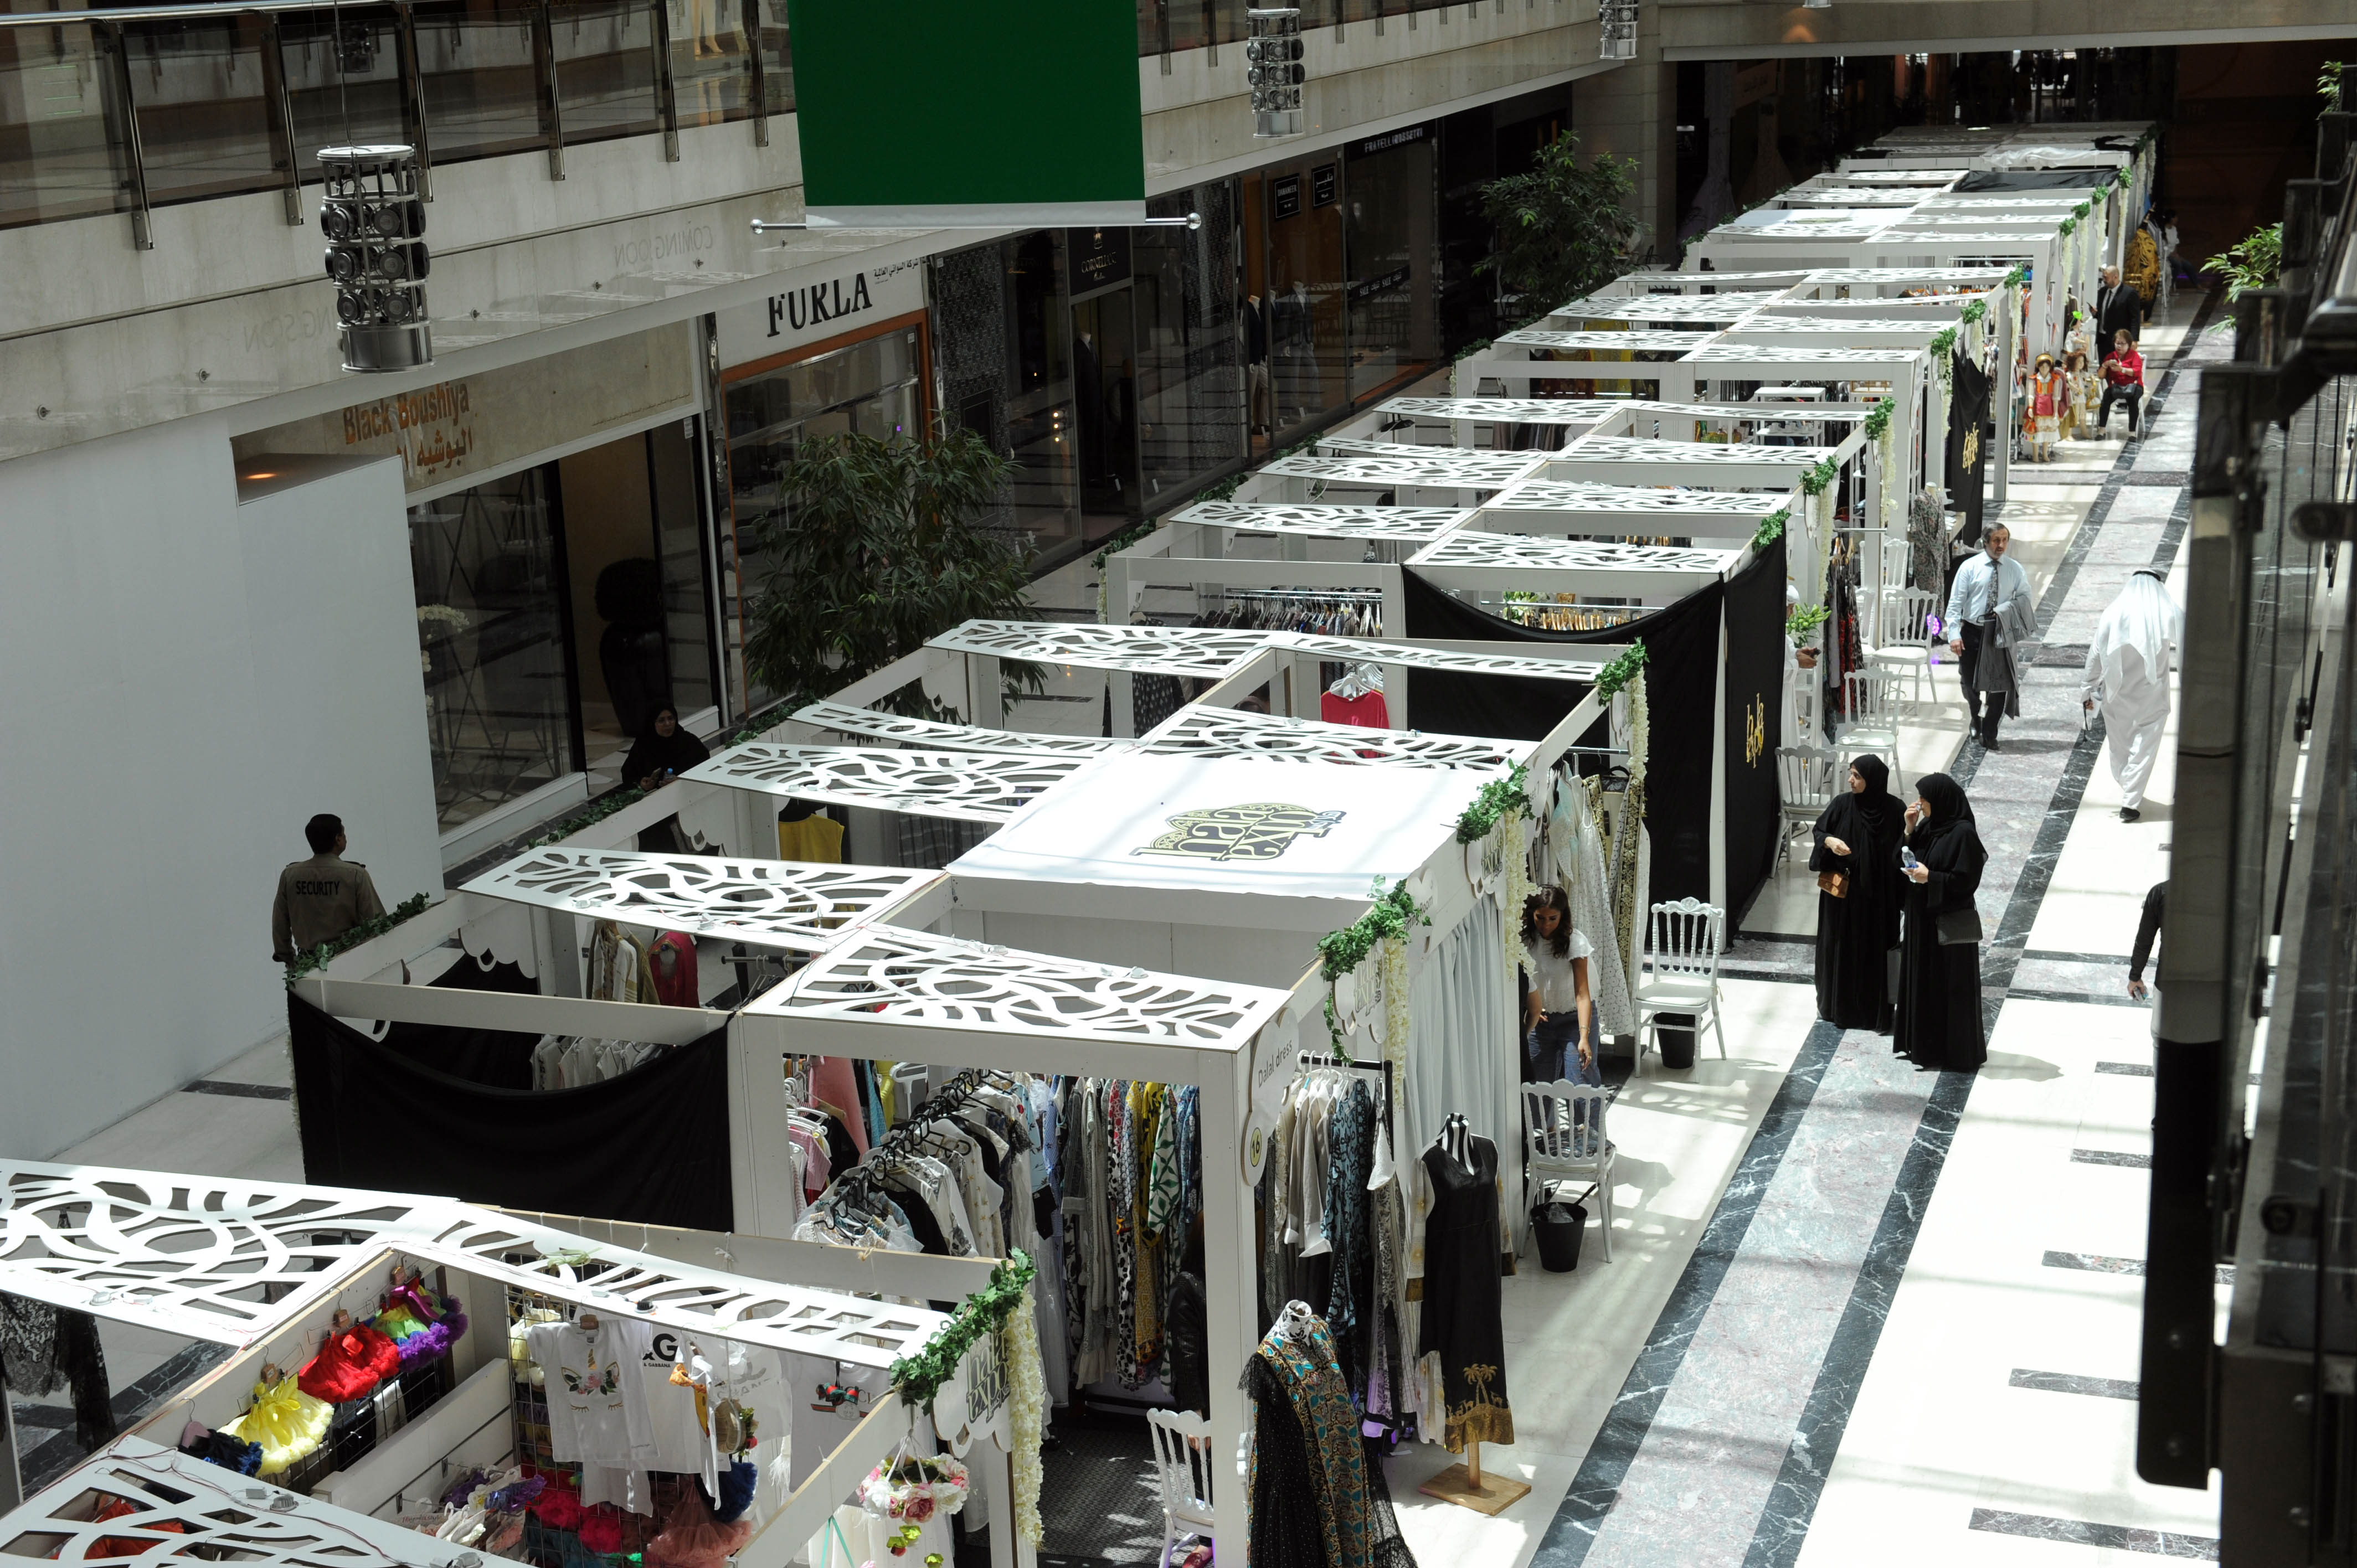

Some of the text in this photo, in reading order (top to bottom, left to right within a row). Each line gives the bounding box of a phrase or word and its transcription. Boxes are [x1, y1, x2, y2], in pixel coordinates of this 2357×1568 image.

[766, 272, 873, 338] FURLA
[343, 381, 470, 445] Black Boushiya
[296, 880, 341, 896] SECURITY
[1419, 895, 1433, 916] Room
[1258, 1039, 1293, 1089] Dalal dress
[1251, 1135, 1260, 1159] 16
